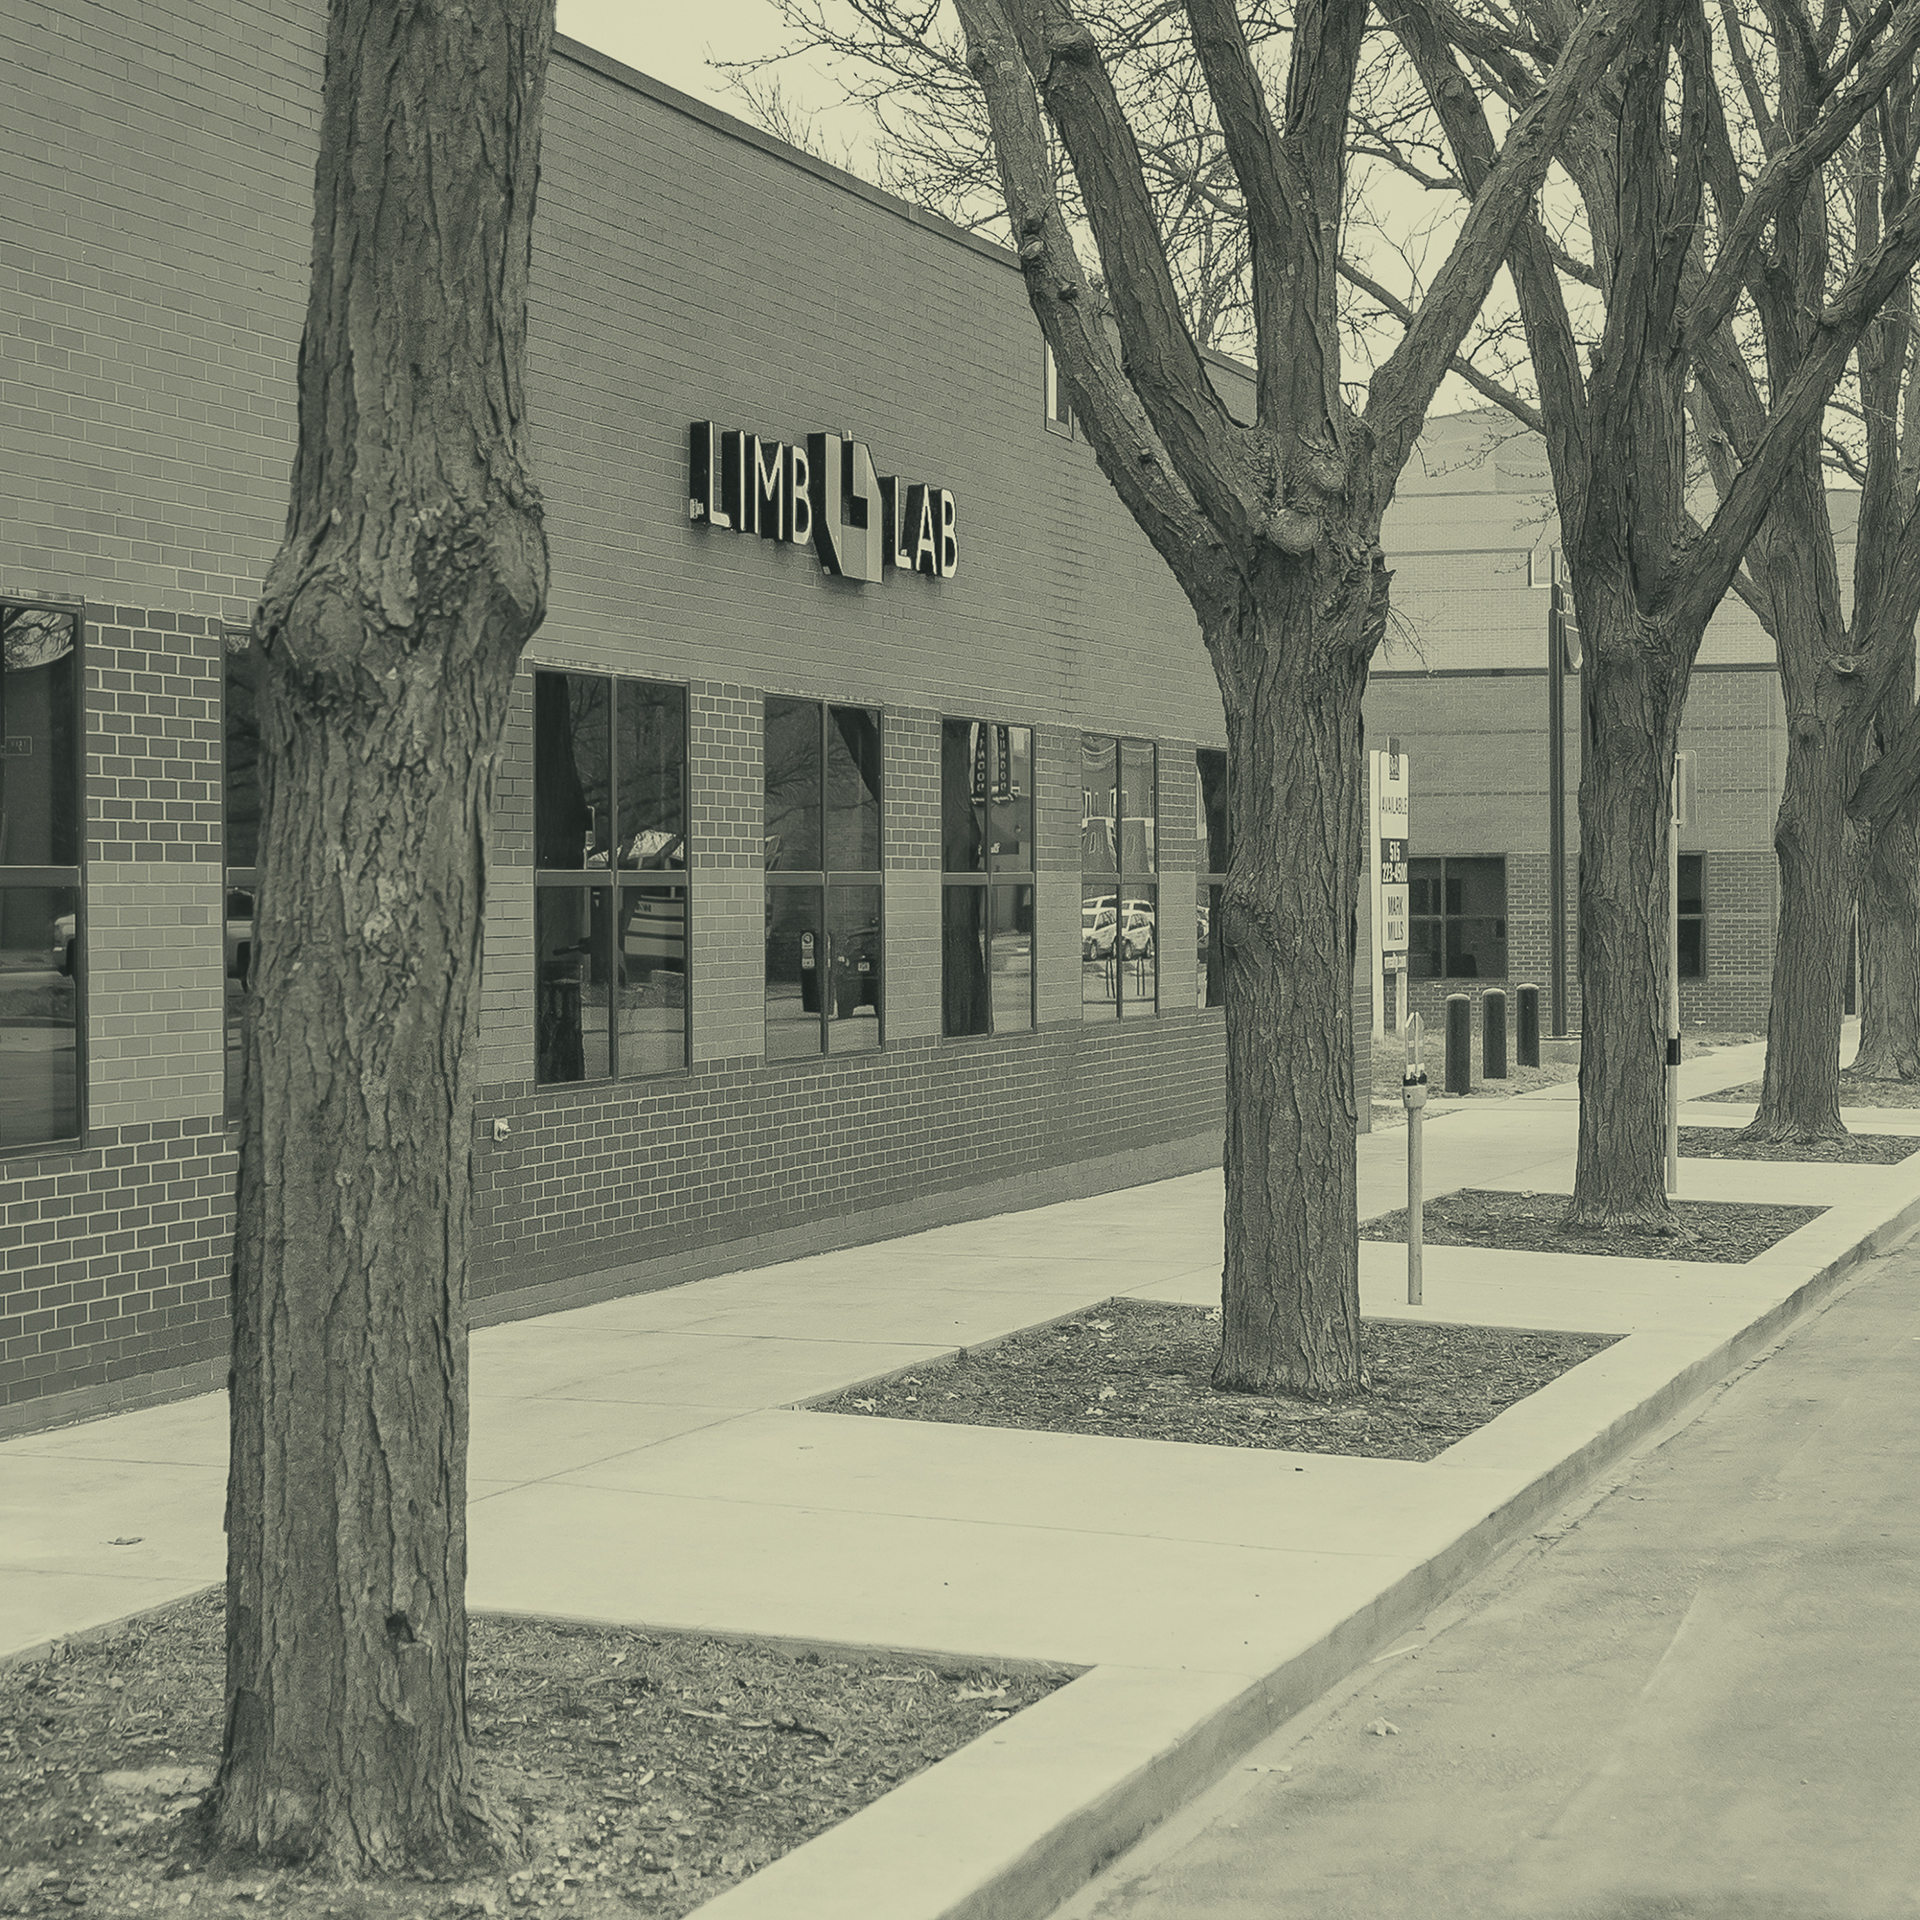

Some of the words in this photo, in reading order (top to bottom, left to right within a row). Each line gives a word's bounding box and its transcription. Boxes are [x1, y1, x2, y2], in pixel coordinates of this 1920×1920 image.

[708, 420, 812, 546] LIMB
[894, 476, 959, 578] LAB
[1379, 796, 1407, 815] AVAILABLE
[1389, 841, 1401, 861] 515
[1382, 862, 1407, 882] 223-4500
[1388, 896, 1404, 915] MARK
[1388, 921, 1405, 941] MILLS
